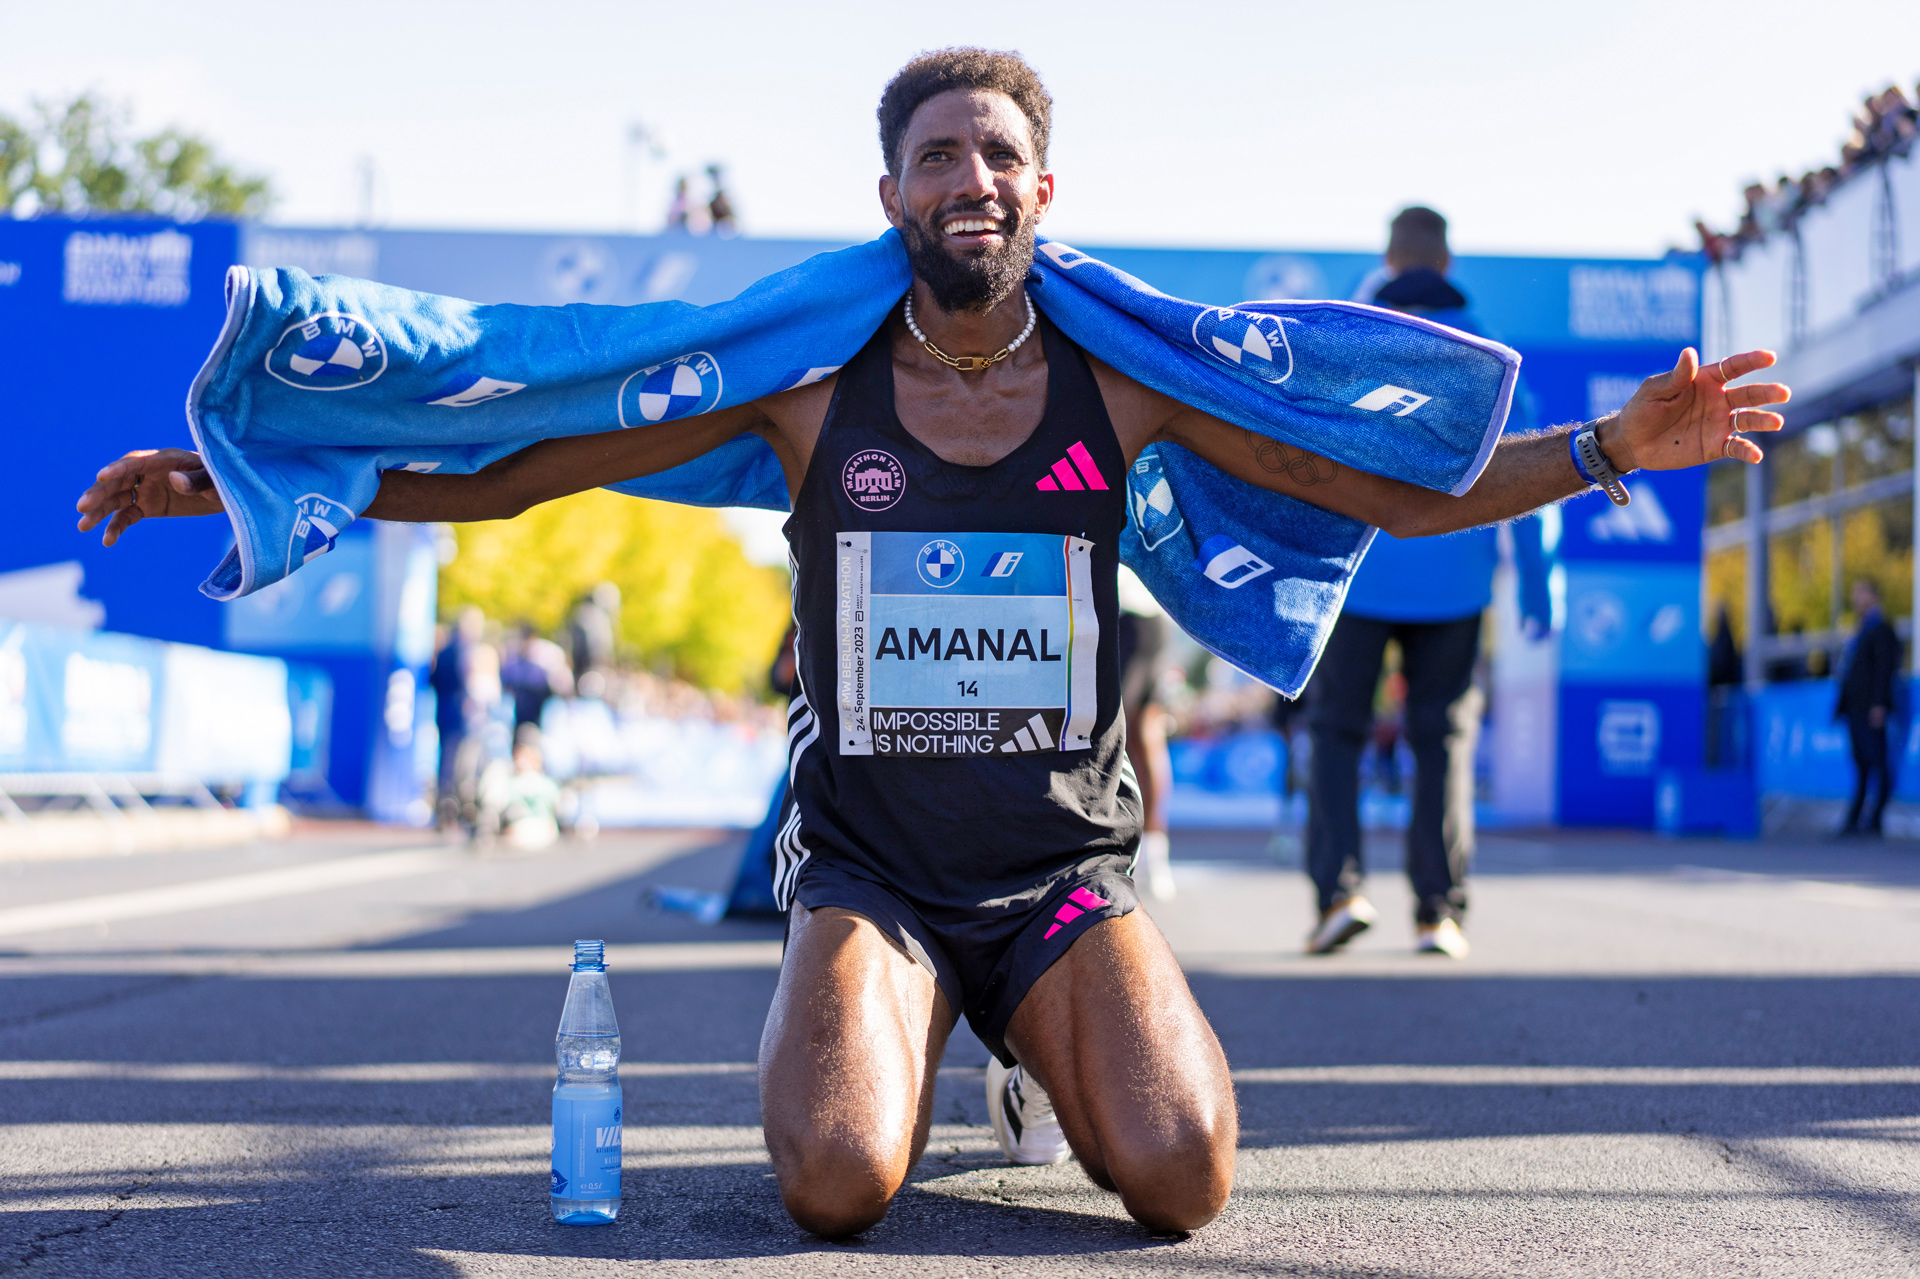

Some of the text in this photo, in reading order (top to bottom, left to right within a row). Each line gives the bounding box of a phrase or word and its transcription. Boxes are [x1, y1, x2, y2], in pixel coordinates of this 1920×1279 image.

[302, 319, 380, 358] BMW
[846, 454, 902, 490] MARATHON TEAM
[860, 494, 890, 502] BERLIN
[923, 542, 958, 556] BMW
[841, 556, 852, 678] BERLIN-MARATHON
[875, 627, 1062, 662] AMANAL
[854, 626, 866, 732] 24. September 2023
[957, 680, 978, 697] 14
[841, 681, 851, 711] BMW
[873, 711, 1000, 731] IMPOSSIBLE
[875, 734, 995, 753] IS NOTHING
